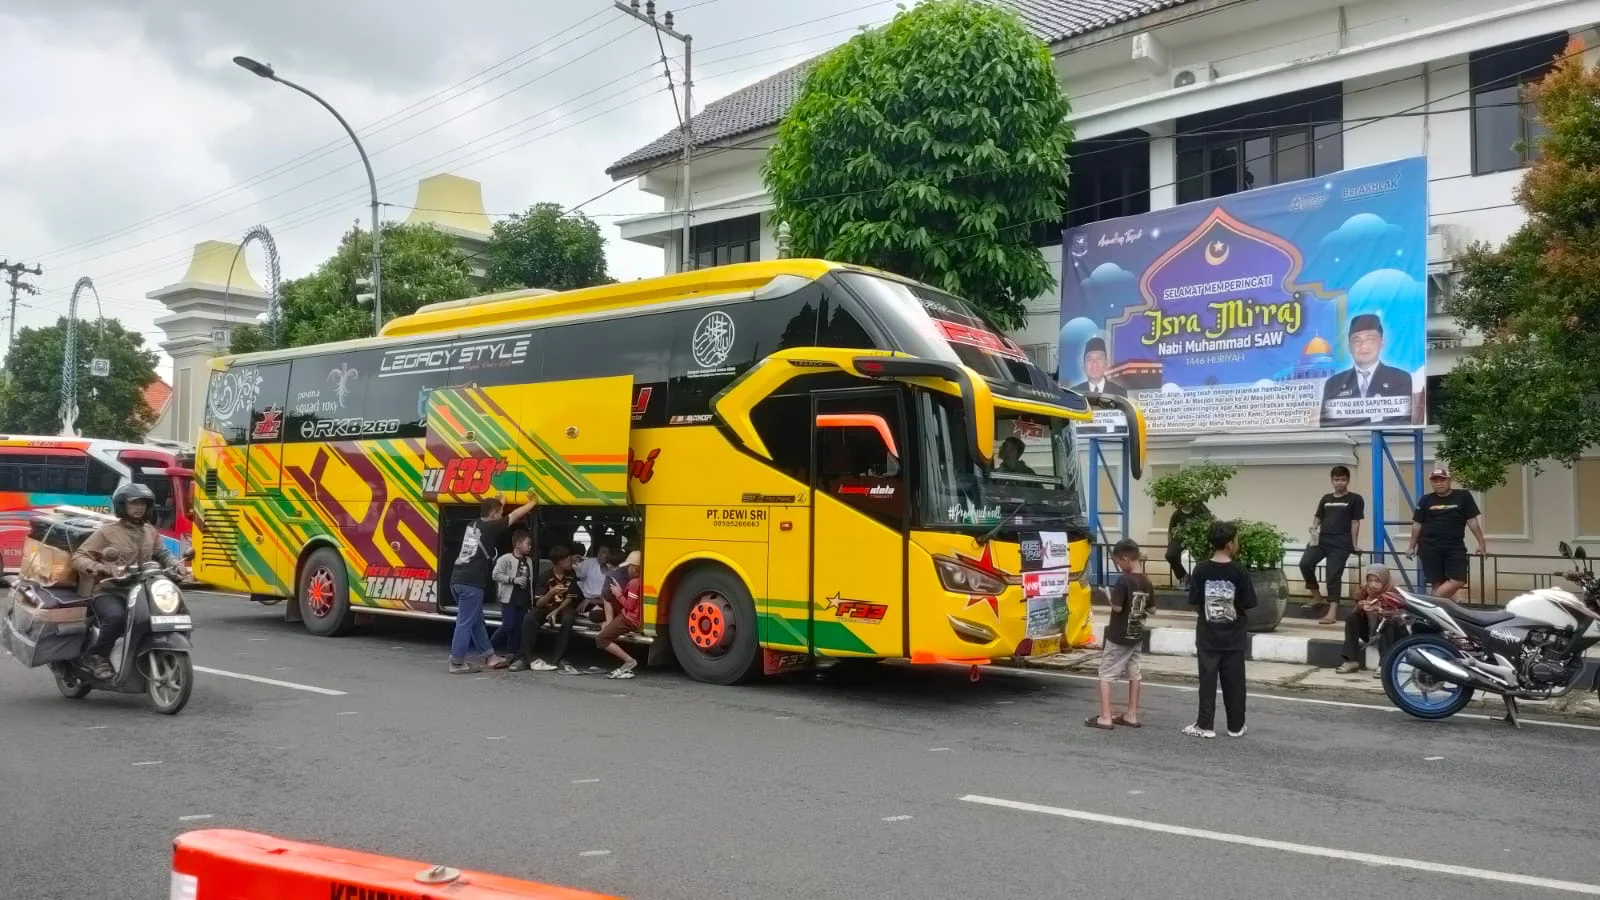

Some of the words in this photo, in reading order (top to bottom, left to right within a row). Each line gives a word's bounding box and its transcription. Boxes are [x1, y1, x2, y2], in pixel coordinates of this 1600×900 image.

[1164, 285, 1203, 300] SELAMAT
[1204, 274, 1272, 295] MEMPERINGATI
[1141, 311, 1201, 345] Isra
[1158, 342, 1182, 356] Nabi
[1185, 335, 1251, 353] Muhammad
[1255, 331, 1283, 347] SAW
[380, 350, 457, 372] LEGACY
[459, 341, 530, 363] STYLE
[1186, 356, 1205, 366] 1446
[296, 399, 320, 416] squad
[706, 509, 720, 520] PT.
[722, 509, 748, 520] DEWI
[750, 509, 767, 521] SRI
